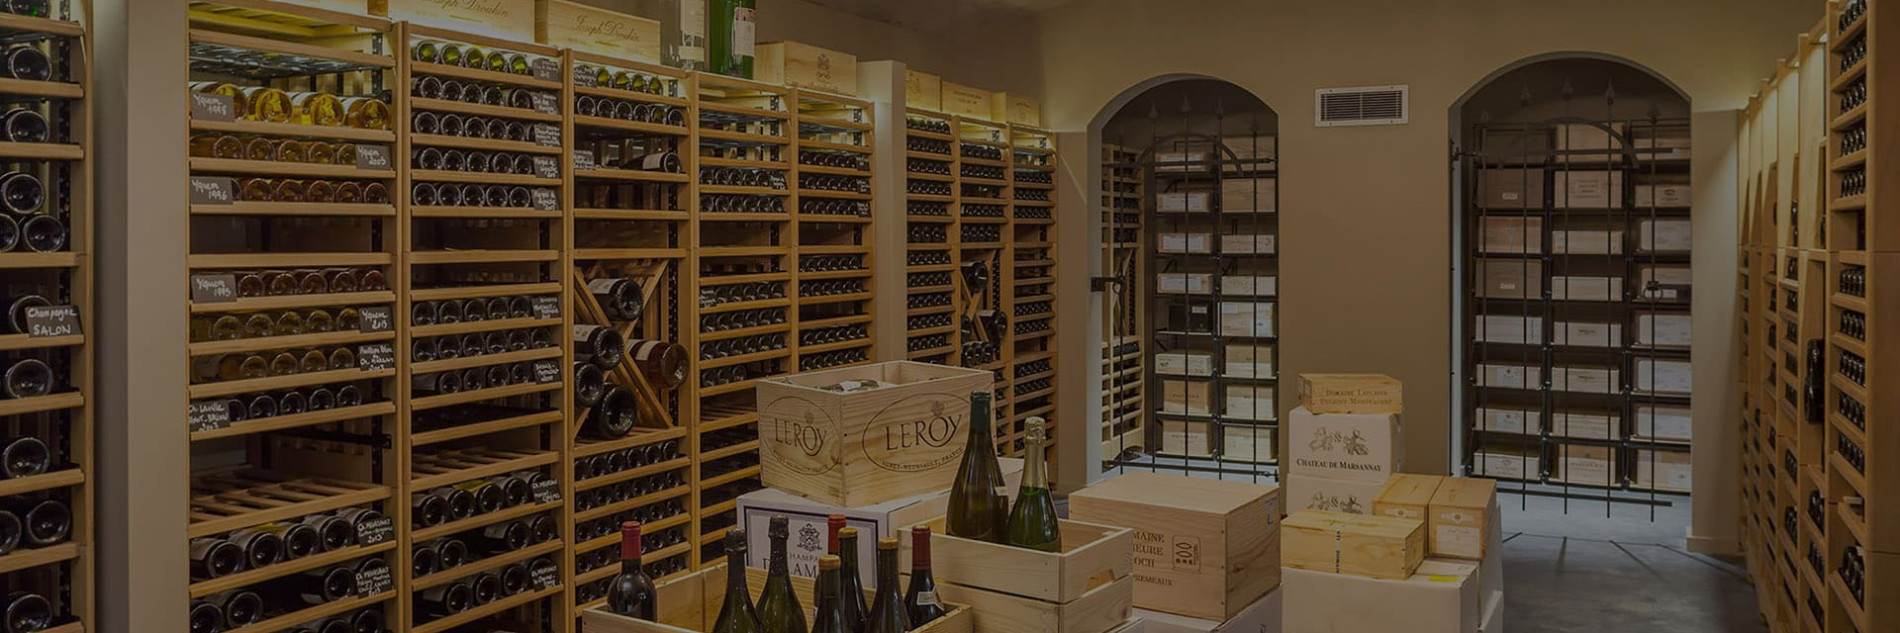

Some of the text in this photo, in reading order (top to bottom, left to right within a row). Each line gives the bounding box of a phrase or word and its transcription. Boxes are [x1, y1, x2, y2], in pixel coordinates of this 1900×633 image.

[191, 179, 220, 193] Yquem
[196, 278, 226, 291] Yquem
[27, 308, 78, 321] Champagne
[33, 324, 71, 336] SALON
[774, 418, 827, 456] LEROY
[885, 414, 962, 448] LEROY
[1329, 461, 1338, 469] DE
[1340, 462, 1381, 471] MARSANNAY
[1133, 531, 1165, 543] MAINE
[1134, 557, 1155, 568] OCH
